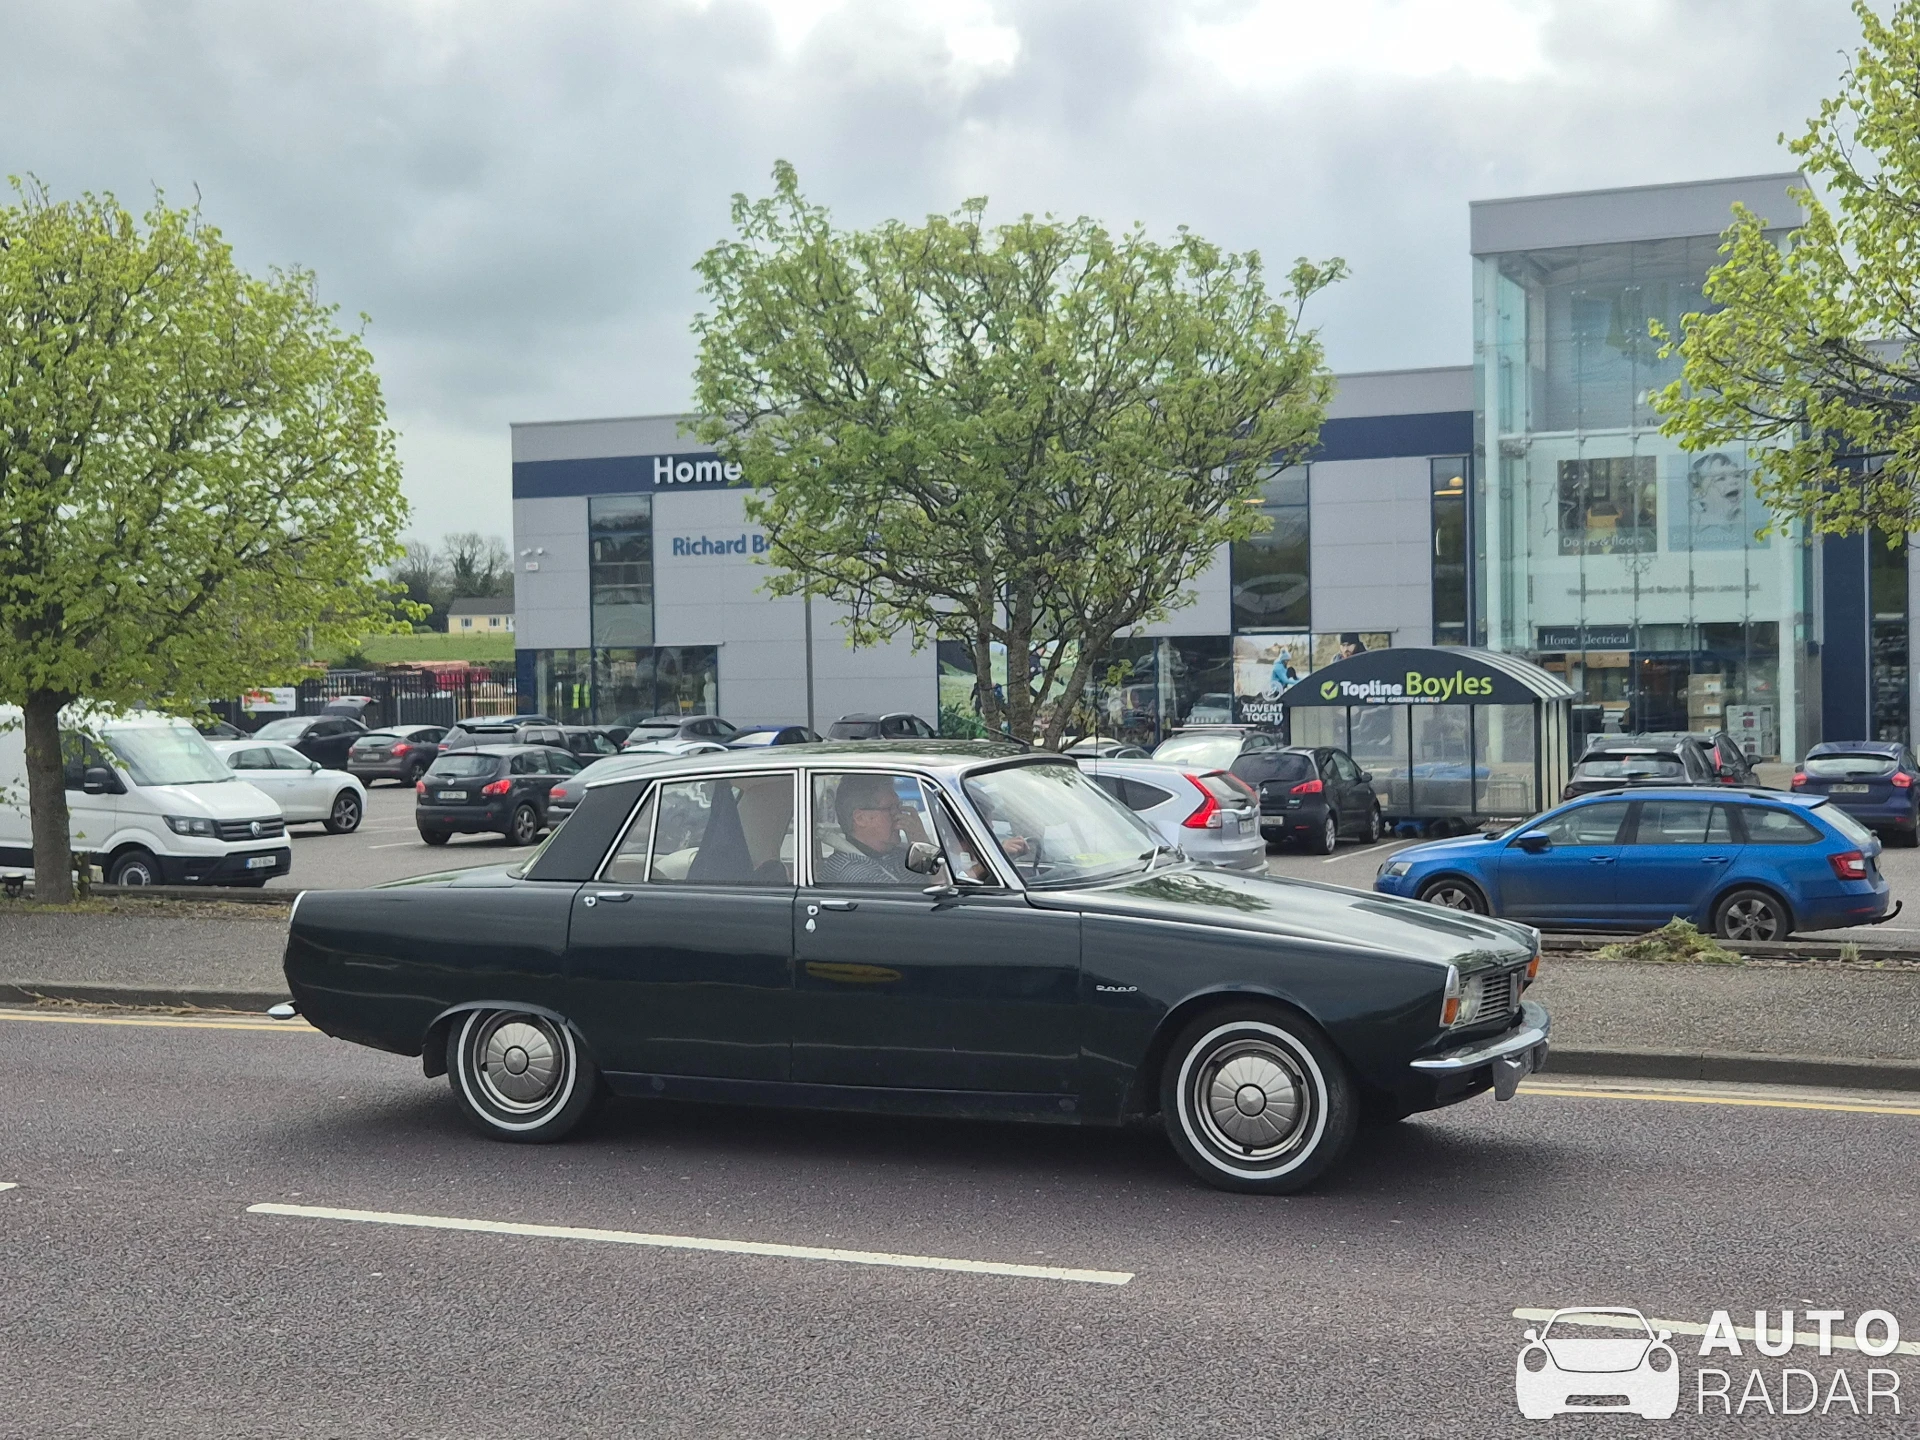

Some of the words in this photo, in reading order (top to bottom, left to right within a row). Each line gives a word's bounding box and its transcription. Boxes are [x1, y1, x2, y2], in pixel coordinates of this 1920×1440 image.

[654, 456, 743, 484] Home
[673, 534, 747, 556] Richard
[1544, 634, 1577, 646] Home
[1340, 680, 1402, 699] Topline
[1406, 670, 1493, 701] Boyles
